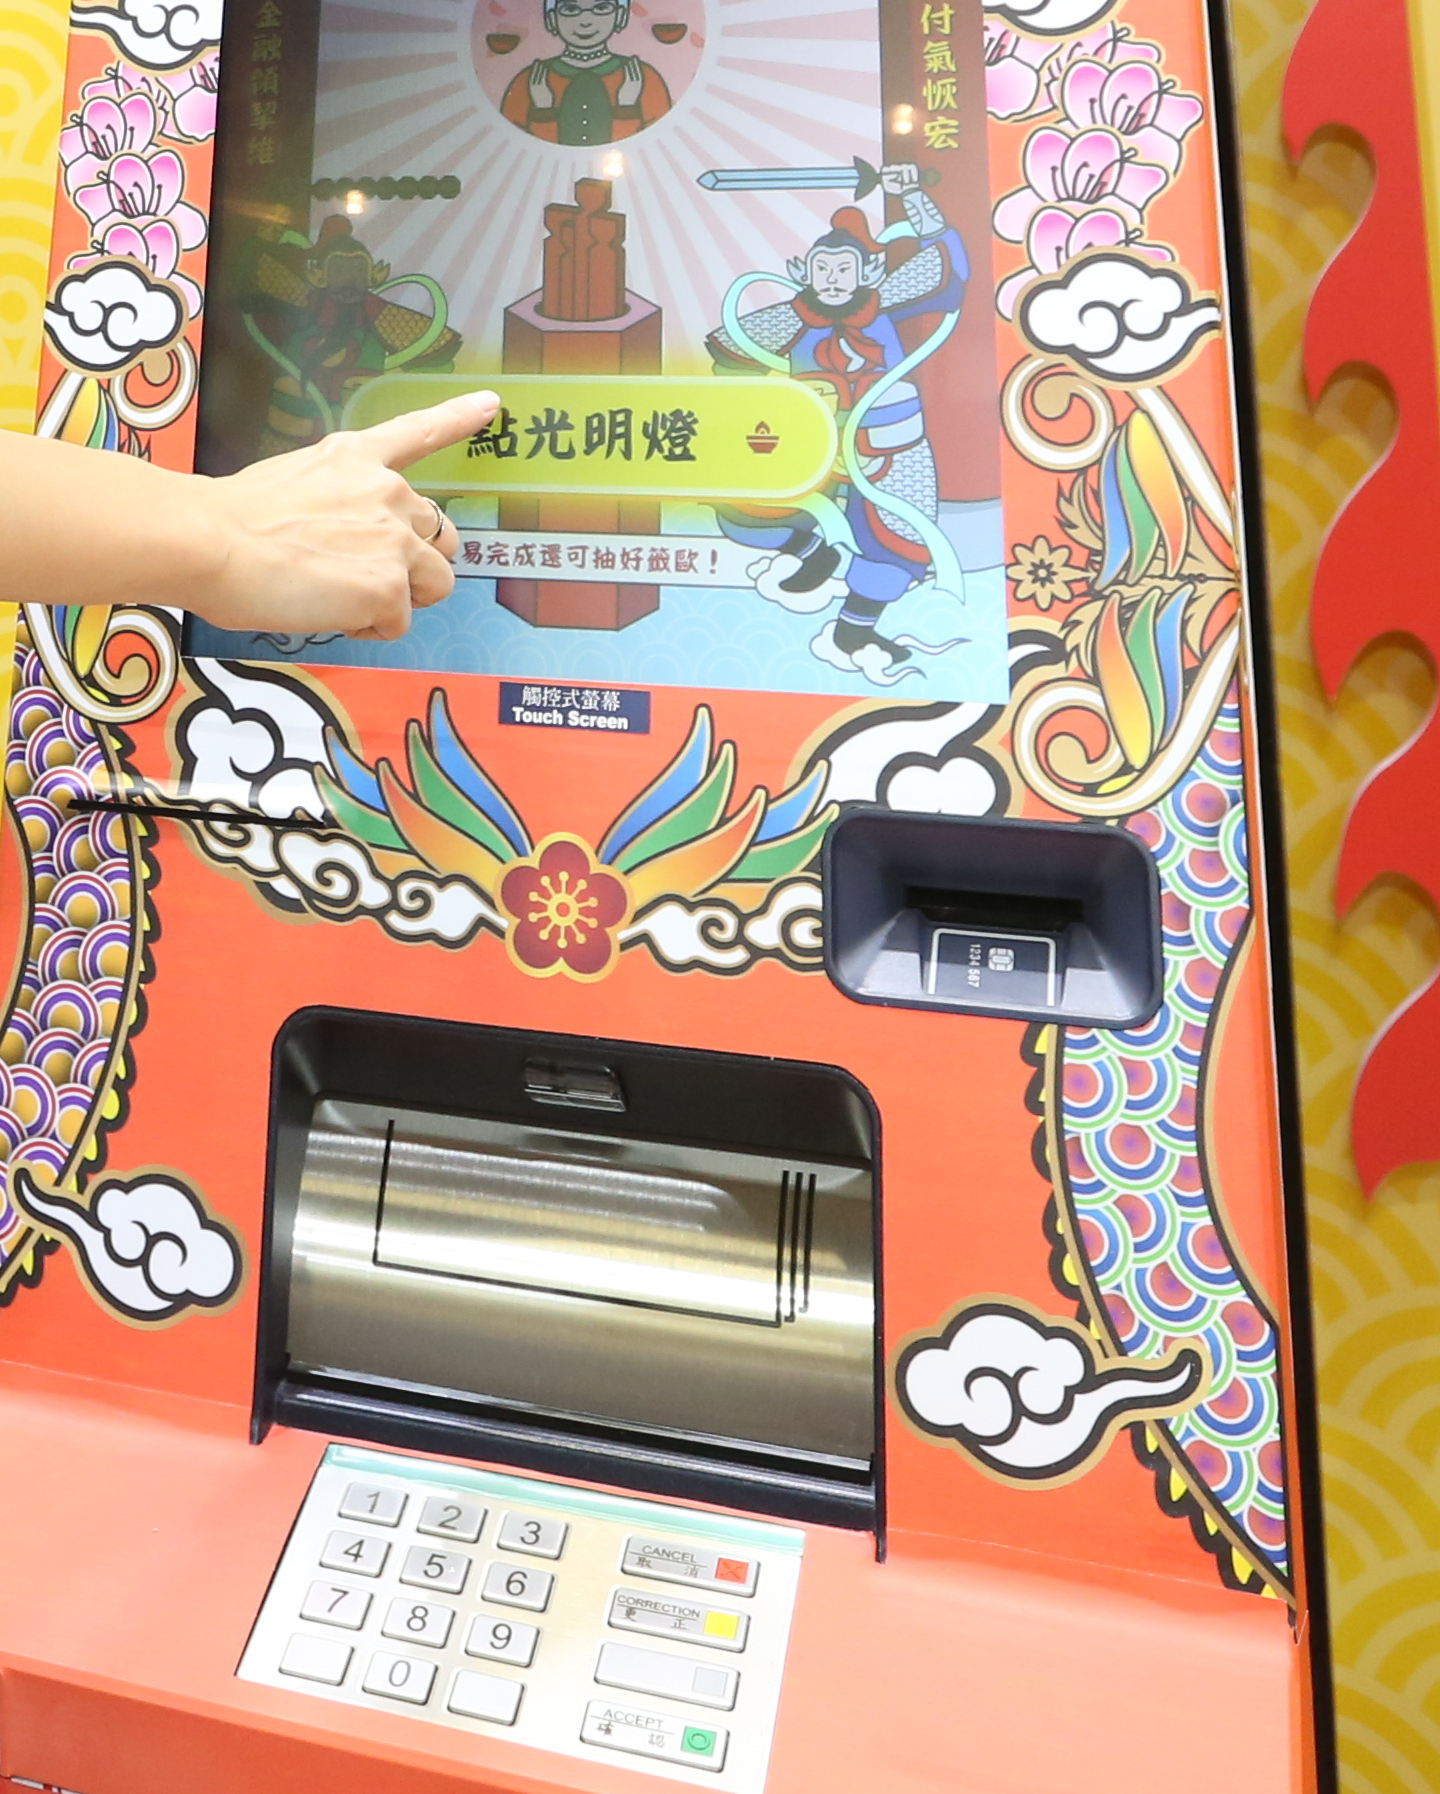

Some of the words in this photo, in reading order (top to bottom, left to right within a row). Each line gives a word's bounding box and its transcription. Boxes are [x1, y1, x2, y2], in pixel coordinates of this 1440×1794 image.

[467, 408, 699, 461] 點光明燈
[448, 541, 718, 574] 易完成還可抽好籤歐！
[522, 685, 620, 711] 觸控式螢幕
[513, 707, 563, 726] Touch
[568, 710, 628, 730] Screen
[365, 1491, 380, 1513] 1
[442, 1506, 462, 1529] 2
[520, 1522, 542, 1545] 3
[343, 1540, 364, 1563] 4
[423, 1554, 443, 1578] 5
[505, 1571, 526, 1595] 6
[642, 1546, 697, 1563] CANCEL
[327, 1588, 349, 1613] 7
[406, 1606, 427, 1631] 8
[489, 1624, 511, 1649] 9
[617, 1595, 700, 1618] CORRECTION
[388, 1660, 411, 1686] 0
[603, 1709, 664, 1731] ACCEPT
